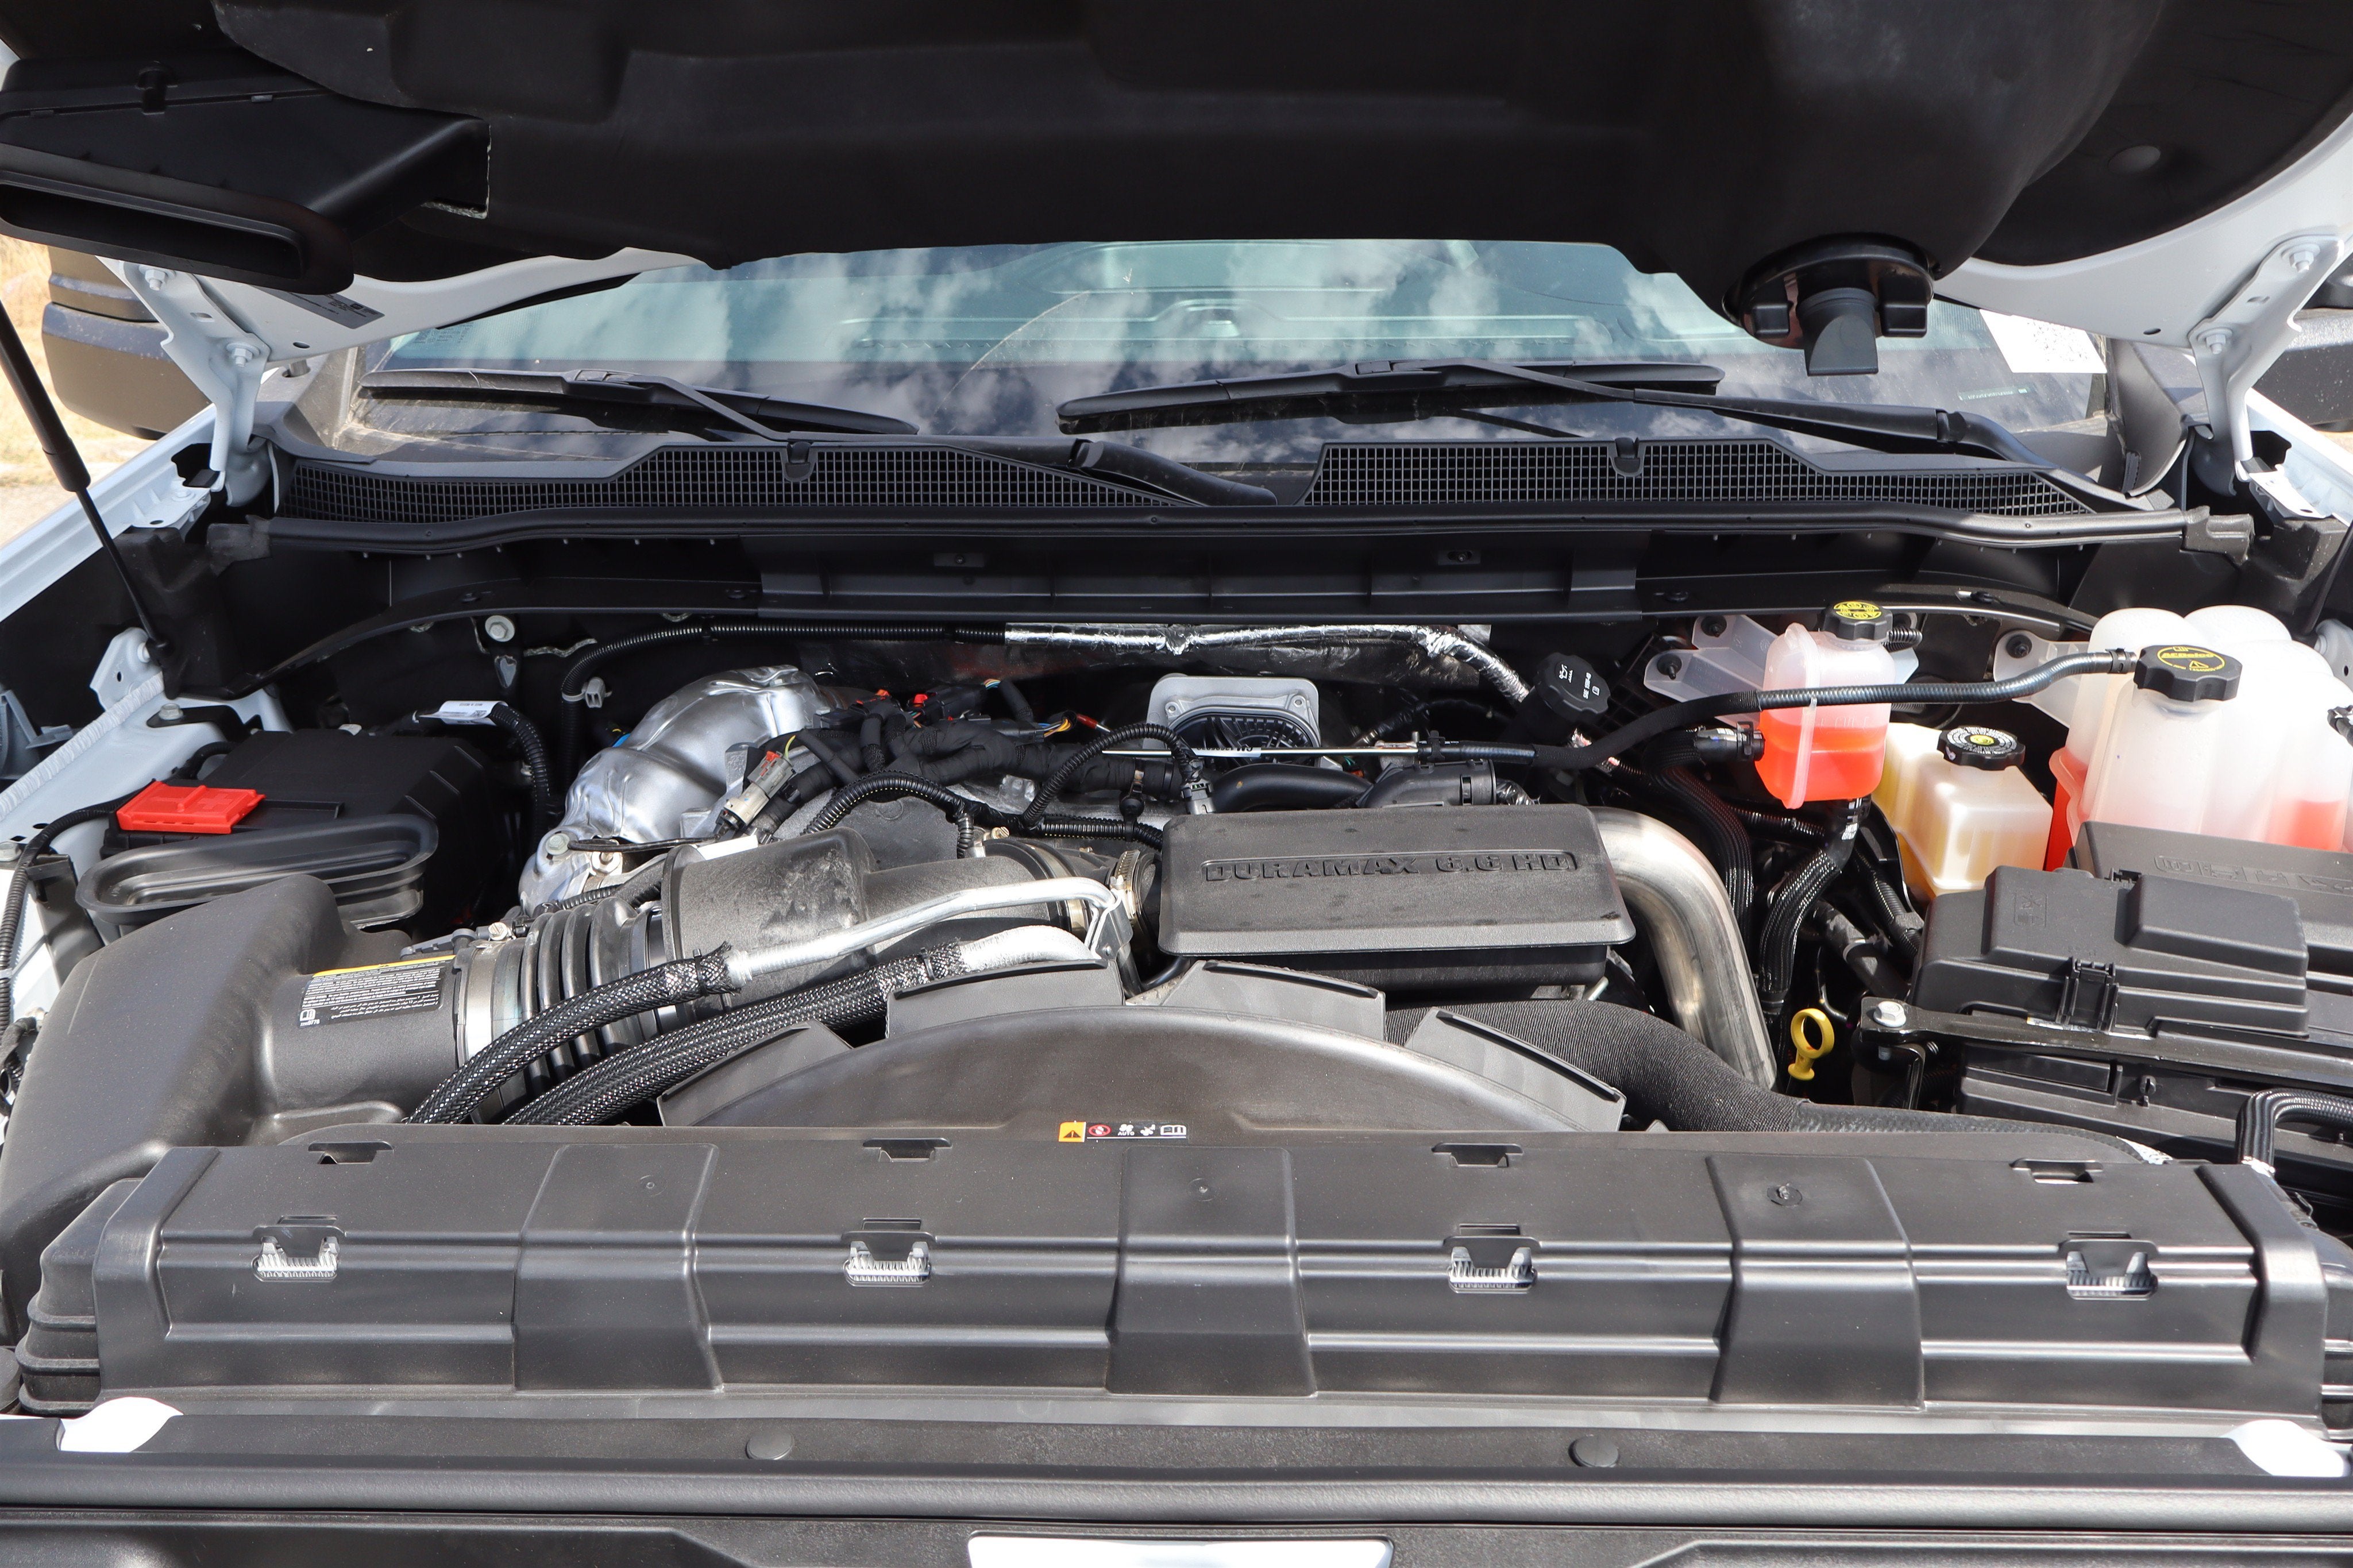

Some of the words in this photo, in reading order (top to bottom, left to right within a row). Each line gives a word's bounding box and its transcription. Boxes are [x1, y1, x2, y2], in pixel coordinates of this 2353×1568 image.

[1203, 855, 1419, 882] DURAMAX
[1435, 856, 1502, 872] 6.6
[1513, 853, 1572, 871] HD
